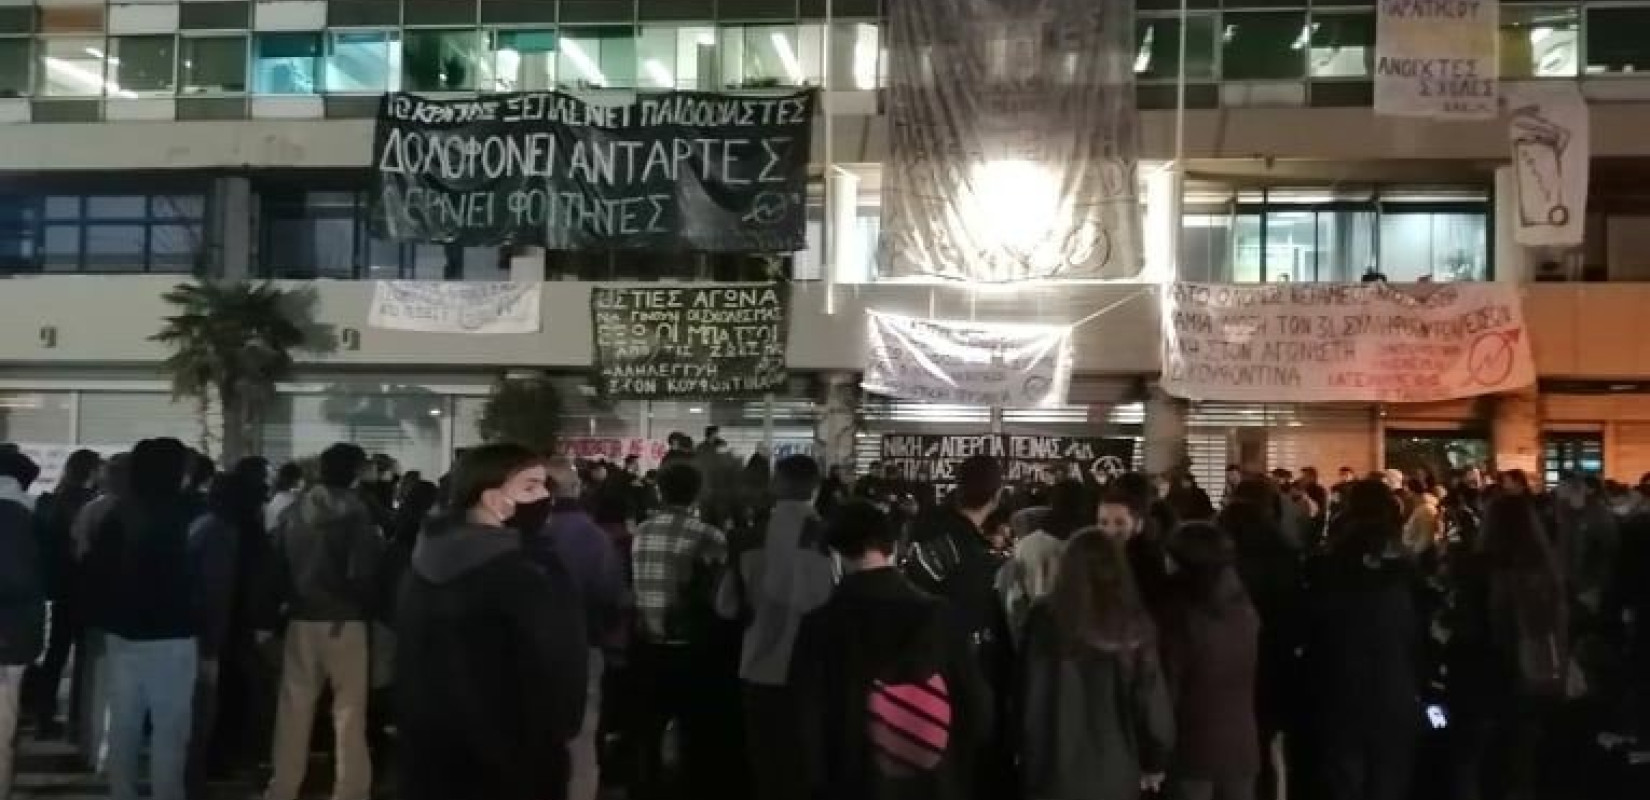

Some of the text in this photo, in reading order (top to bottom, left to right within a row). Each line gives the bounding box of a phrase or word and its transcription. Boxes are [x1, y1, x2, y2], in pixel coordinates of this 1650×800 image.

[379, 127, 795, 186] ΔΟΛΟΦΟΝΕΙ ΑΝΤΑΡΤΕΣ
[693, 289, 780, 308] ΑΓΩΝΑ
